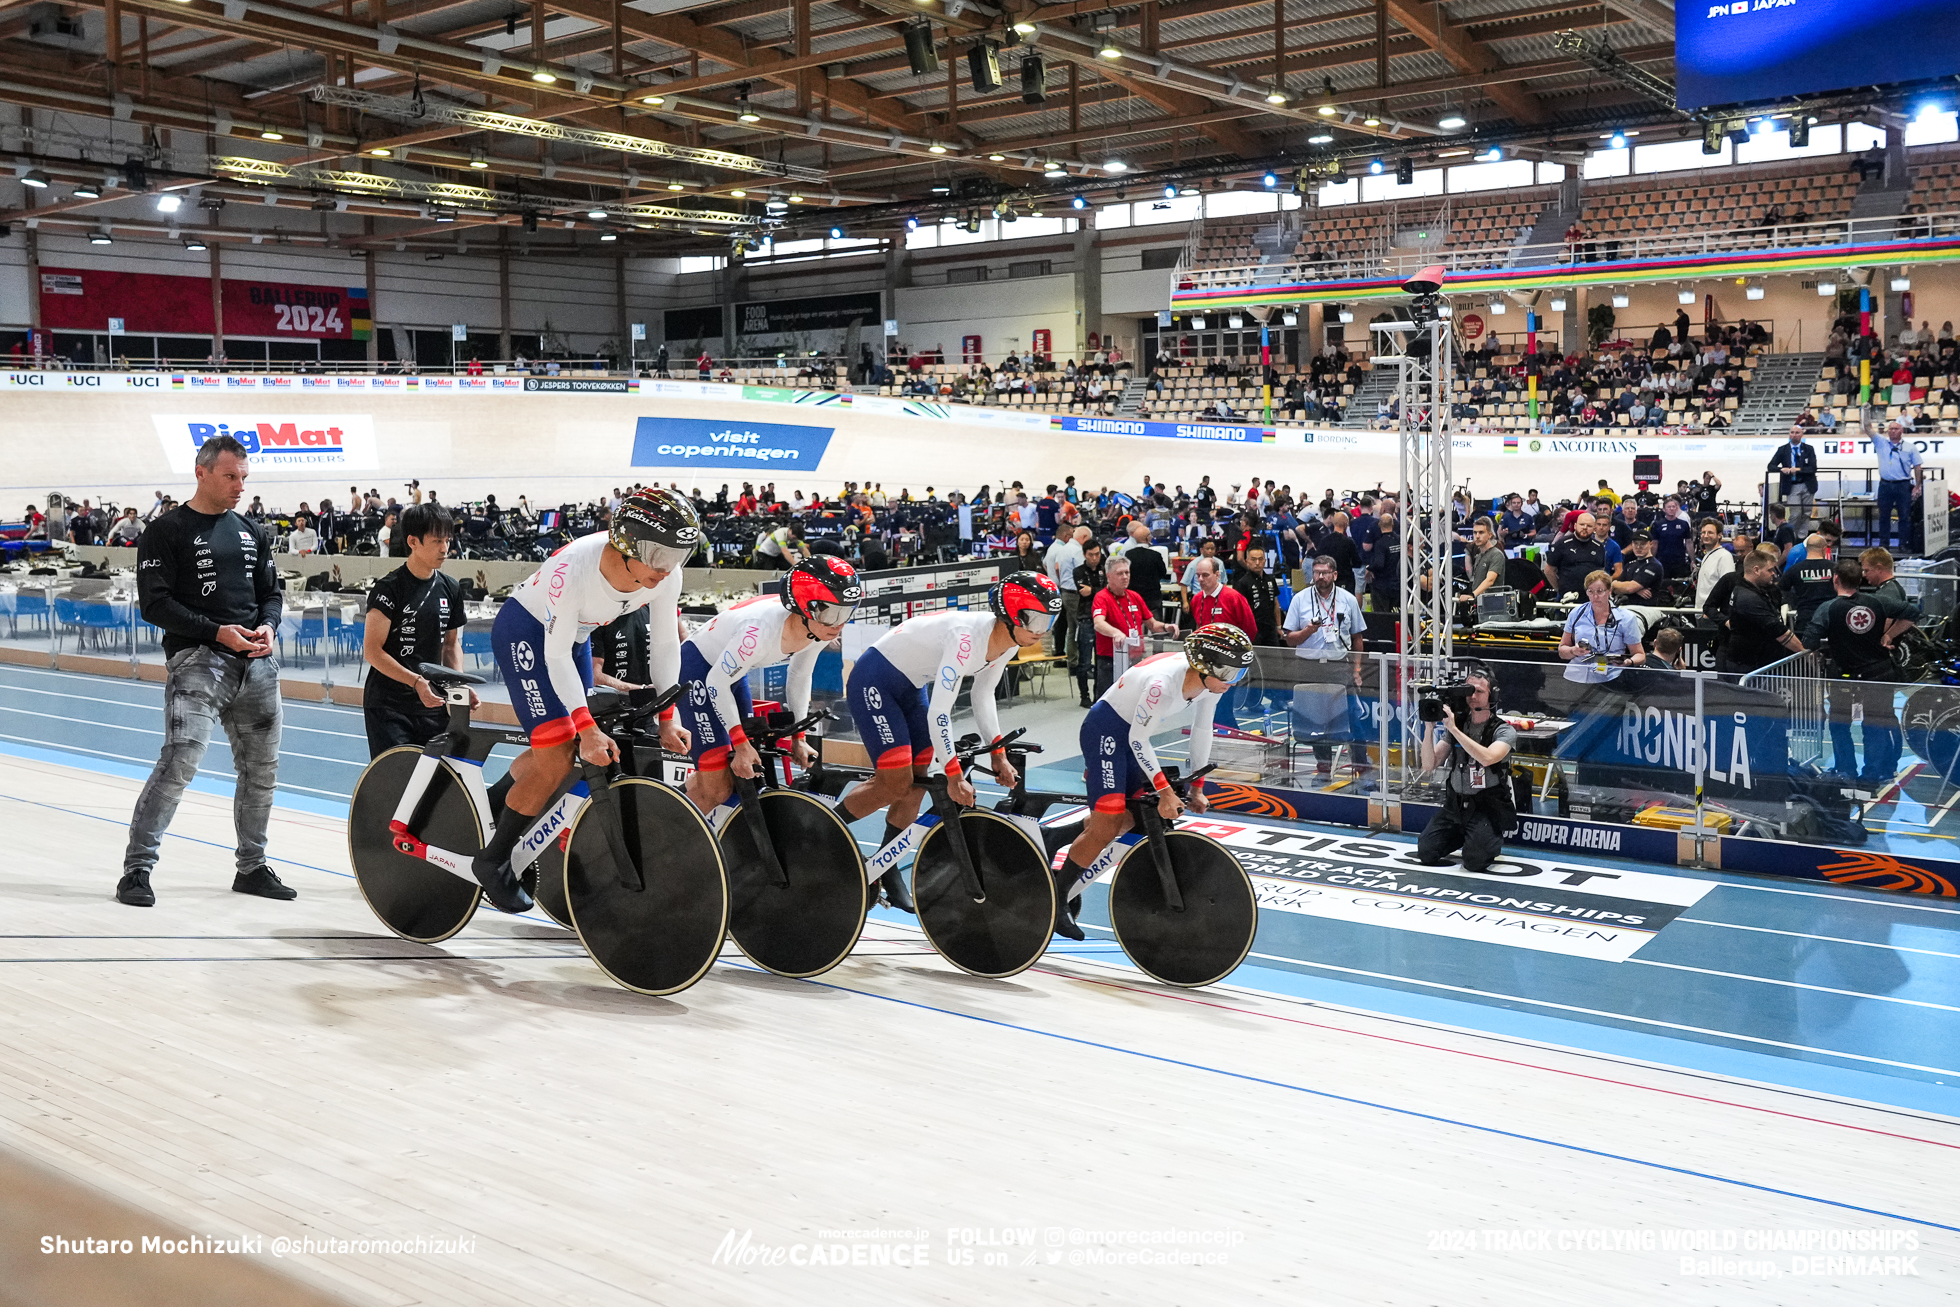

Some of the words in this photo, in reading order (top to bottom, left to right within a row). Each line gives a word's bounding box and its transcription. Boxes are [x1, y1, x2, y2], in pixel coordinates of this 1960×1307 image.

[1707, 4, 1729, 18] JPN
[250, 286, 341, 309] BALLERUP
[274, 303, 344, 334] 2024
[745, 305, 767, 320] FOOD
[743, 318, 769, 332] ARENA
[17, 374, 44, 385] UCI
[74, 376, 100, 386] UCI
[131, 377, 159, 387] UCI
[191, 377, 220, 386] BigMat
[227, 377, 256, 386] BigMat
[262, 377, 291, 386] BigMat
[302, 378, 331, 387] BigMat
[337, 378, 365, 387] BigMat
[372, 378, 400, 387] BigMat
[425, 379, 452, 387] BigMat
[459, 379, 486, 388] BigMat
[492, 379, 519, 388] BigMat
[539, 382, 570, 390] JESPERS
[1077, 418, 1145, 435] SHIMANO
[1176, 424, 1246, 441] SHIMANO
[709, 430, 761, 444] visit
[1318, 435, 1357, 444] BORDING
[657, 444, 799, 460] copenhagen
[1549, 440, 1637, 453] ANCOTRANS
[1858, 441, 1944, 454] TOT
[250, 456, 268, 464] OF
[274, 455, 345, 465] BUILDERS
[626, 510, 667, 533] Kabuto
[1800, 568, 1833, 579] ITALIA
[895, 577, 915, 585] TISSOT
[1202, 642, 1237, 659] Kabuto
[521, 678, 547, 717] SPEED
[694, 711, 716, 744] SPEED
[872, 714, 895, 744] SPEED
[505, 733, 518, 743] Toray
[517, 735, 530, 743] Carb
[940, 728, 952, 755] Cyclers
[1137, 751, 1154, 772] Cyclers
[1101, 759, 1115, 789] SPEED
[1522, 821, 1568, 846] SUPER
[1570, 826, 1621, 851] ARENA
[429, 854, 456, 869] JAPAN
[1230, 850, 1291, 865] 024
[1295, 859, 1406, 881] TRACK
[1242, 861, 1321, 879] ORLD
[1326, 875, 1647, 925] CHAMPIONSHIPS
[1351, 898, 1619, 942] COPENHAGEN
